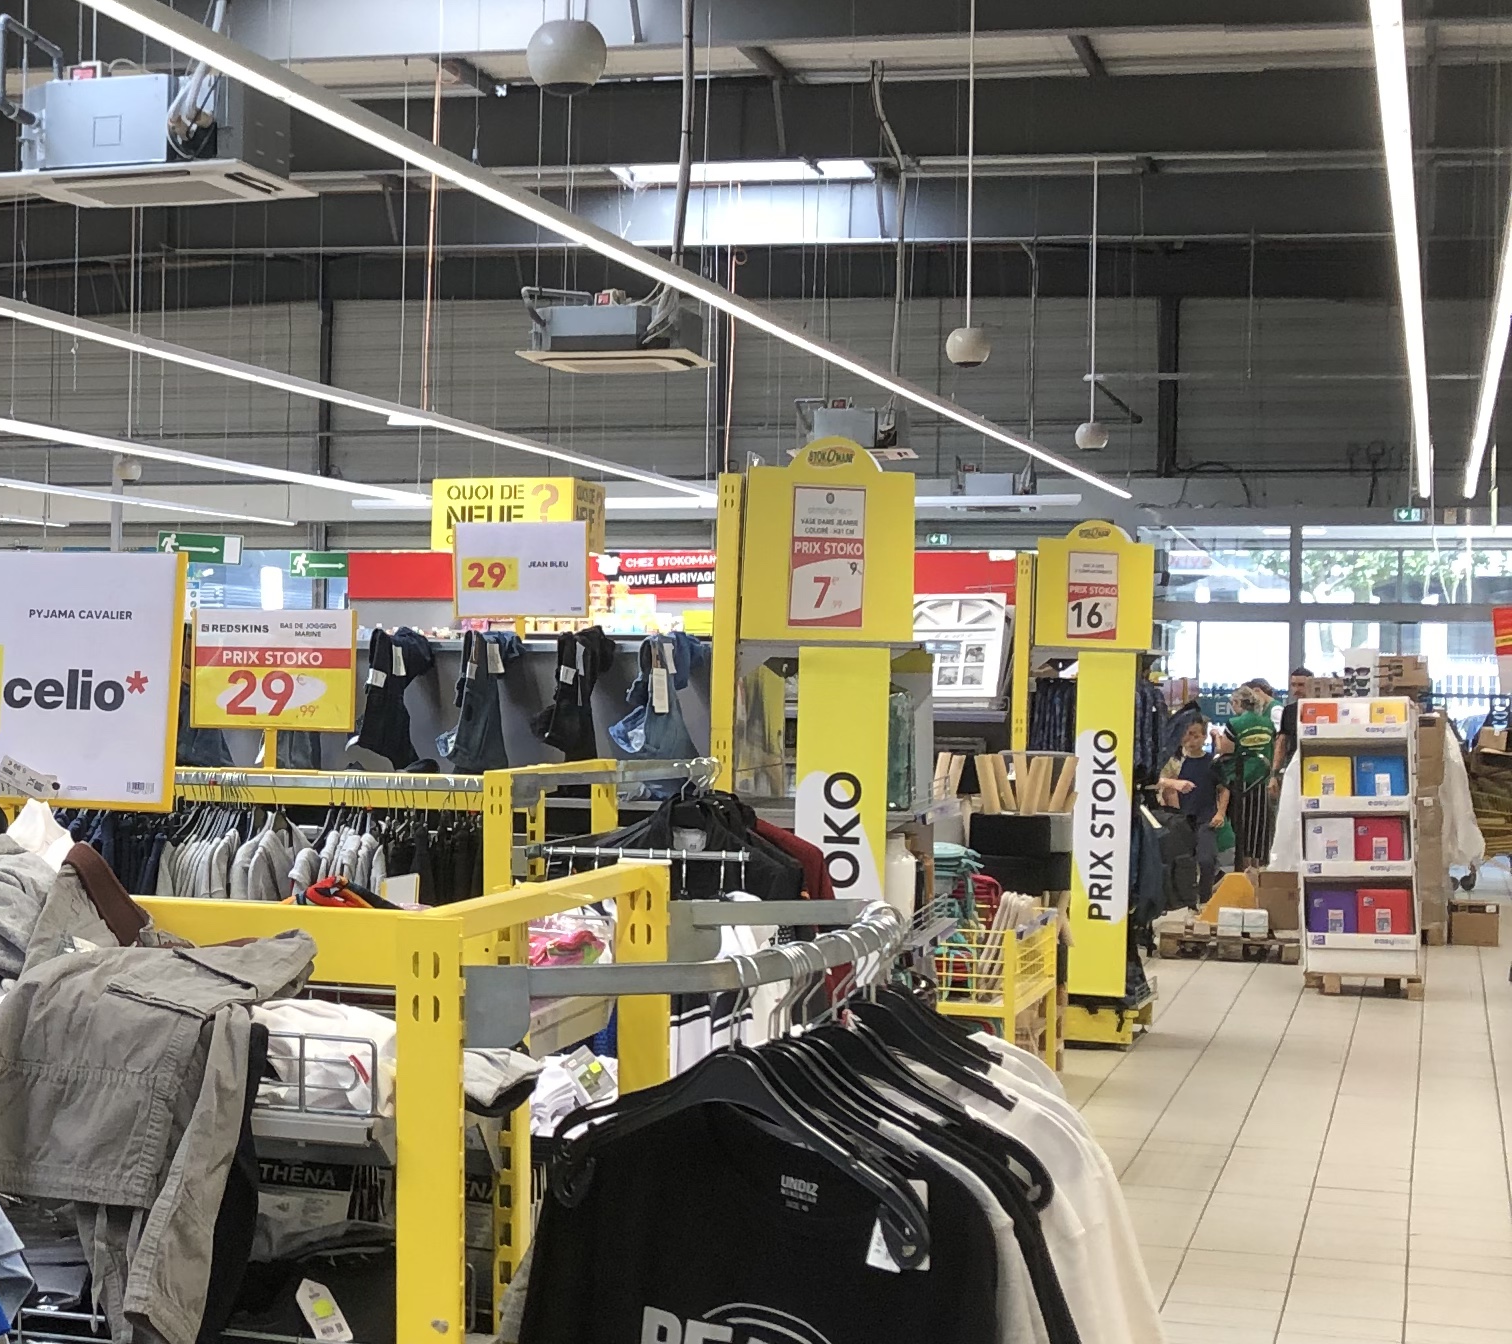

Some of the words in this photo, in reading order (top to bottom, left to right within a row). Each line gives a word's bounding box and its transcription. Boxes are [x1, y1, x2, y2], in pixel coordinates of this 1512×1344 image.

[447, 485, 494, 500] QUOI
[500, 484, 525, 500] DE
[794, 541, 820, 554] PRIX
[823, 542, 863, 556] STOKO
[528, 560, 548, 568] JEAN
[549, 560, 569, 568] BLEU
[625, 557, 654, 568] CHEZ
[656, 554, 716, 567] STOKOMAN
[467, 562, 507, 588] 29
[618, 573, 663, 586] NOUVEL
[813, 576, 832, 609] 7
[1069, 585, 1088, 595] PRIX
[1089, 586, 1117, 595] STOKO
[28, 608, 76, 620] PYJAMA
[78, 609, 134, 621] CAVALIER
[1070, 601, 1103, 629] 16
[211, 623, 270, 634] REDSKINS
[279, 622, 293, 630] BAS
[294, 622, 304, 630] DE
[305, 622, 338, 630] JOGGING
[294, 630, 322, 638] MARINE
[222, 650, 260, 665] PRIX
[264, 651, 324, 666] STOKO
[226, 669, 295, 717] 29
[1090, 729, 1118, 840] STOKO
[1087, 850, 1115, 922] PRIX
[259, 1162, 336, 1188] THENA
[780, 1174, 819, 1196] UNDIZ
